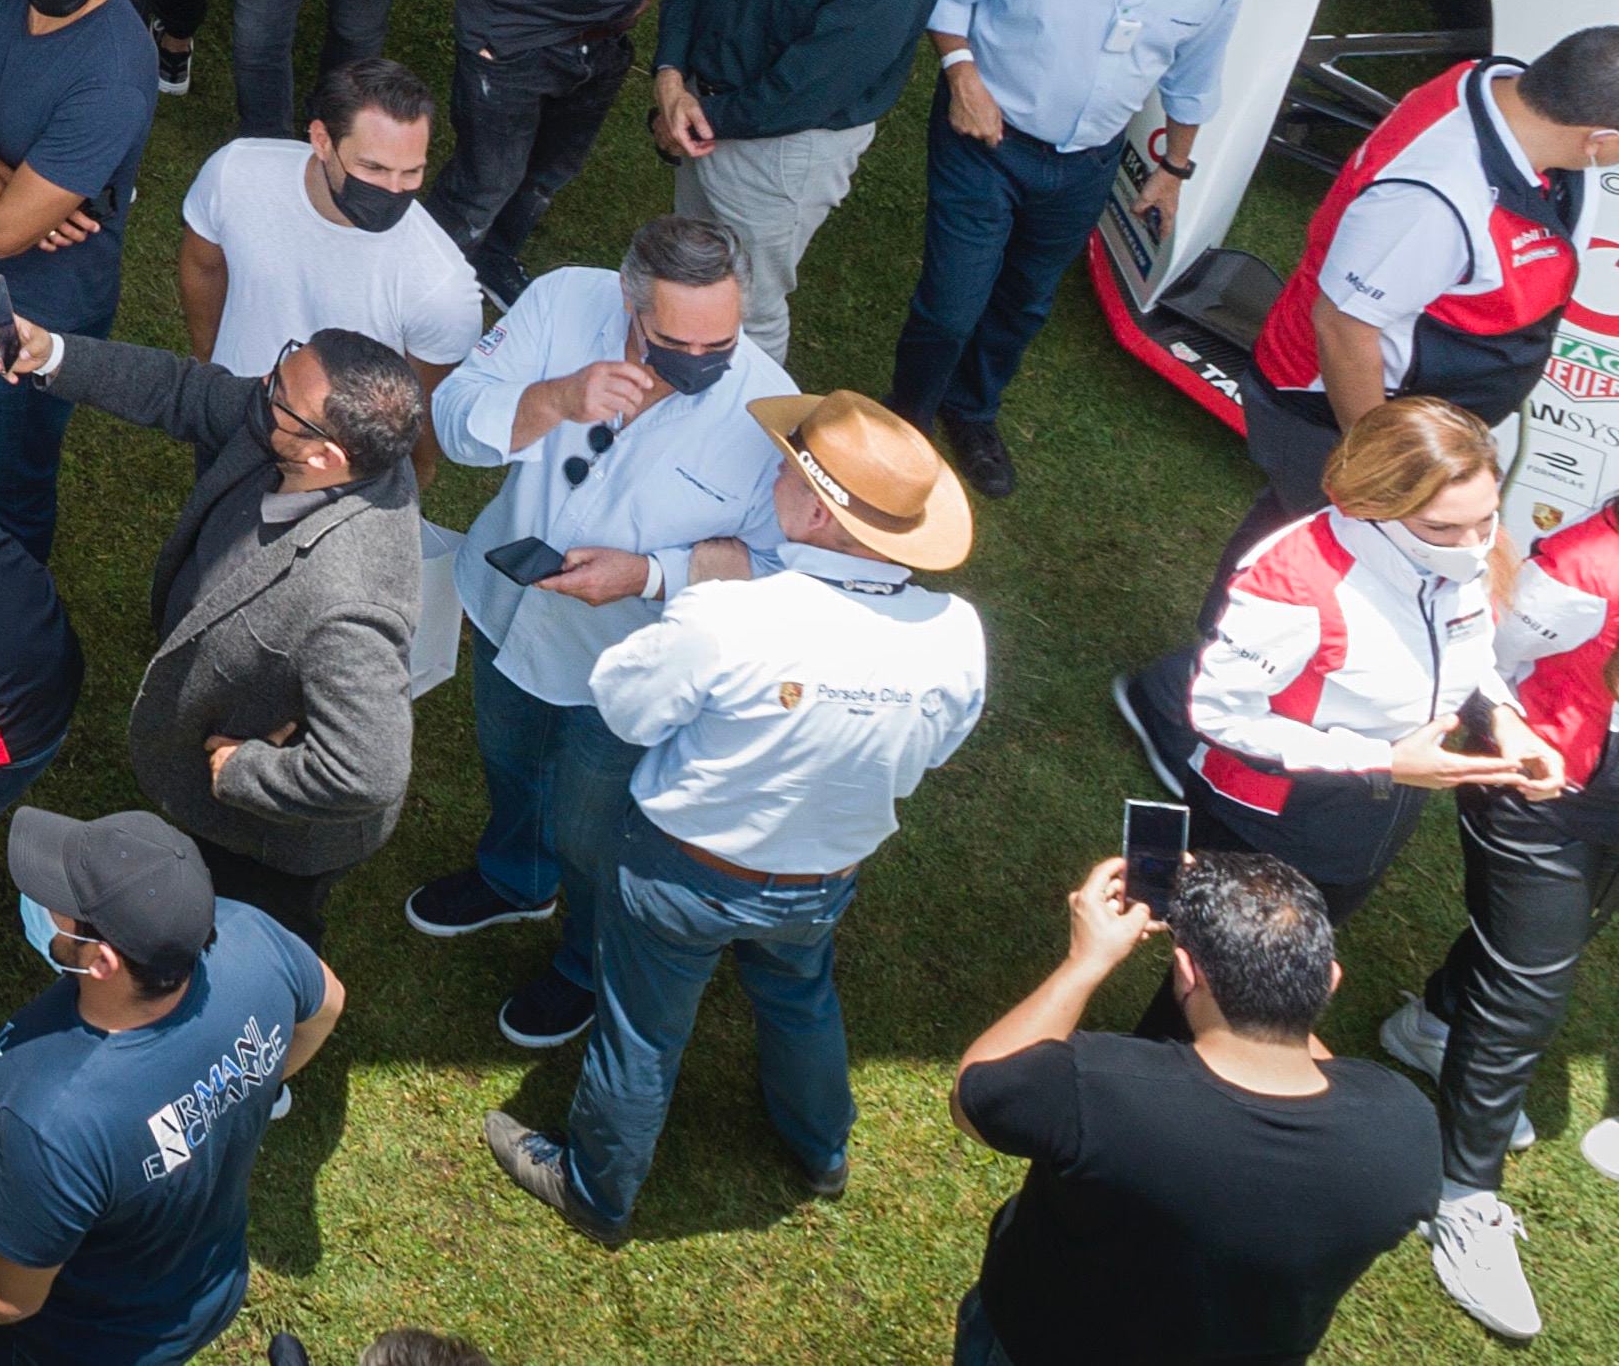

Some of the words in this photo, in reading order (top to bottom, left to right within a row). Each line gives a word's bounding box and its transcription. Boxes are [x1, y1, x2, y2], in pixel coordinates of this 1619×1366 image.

[1526, 465, 1585, 491] FORMULA-E
[817, 684, 875, 703] Porsche
[879, 688, 913, 704] Club
